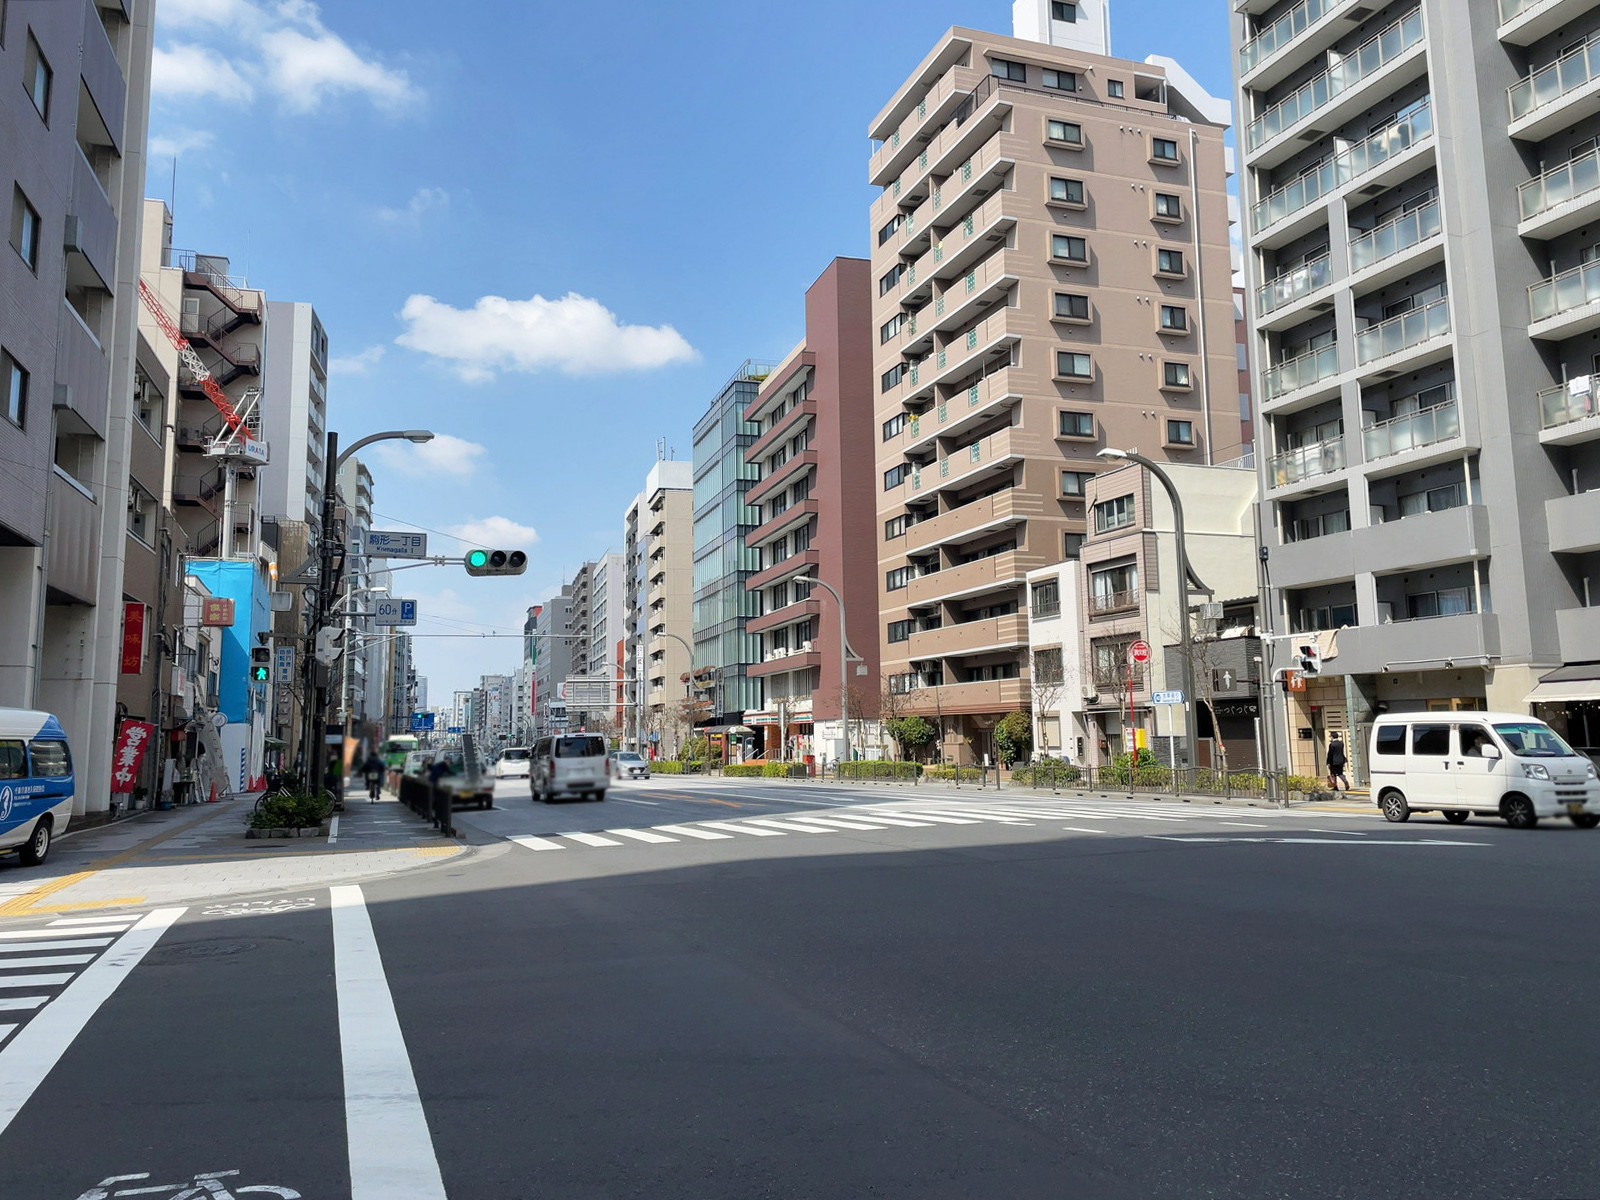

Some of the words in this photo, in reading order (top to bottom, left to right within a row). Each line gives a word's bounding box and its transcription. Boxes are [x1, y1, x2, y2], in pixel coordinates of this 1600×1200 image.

[369, 534, 421, 547] 駒形一丁目
[379, 603, 397, 616] 60分
[404, 602, 412, 613] P
[115, 726, 147, 787] 営業中
